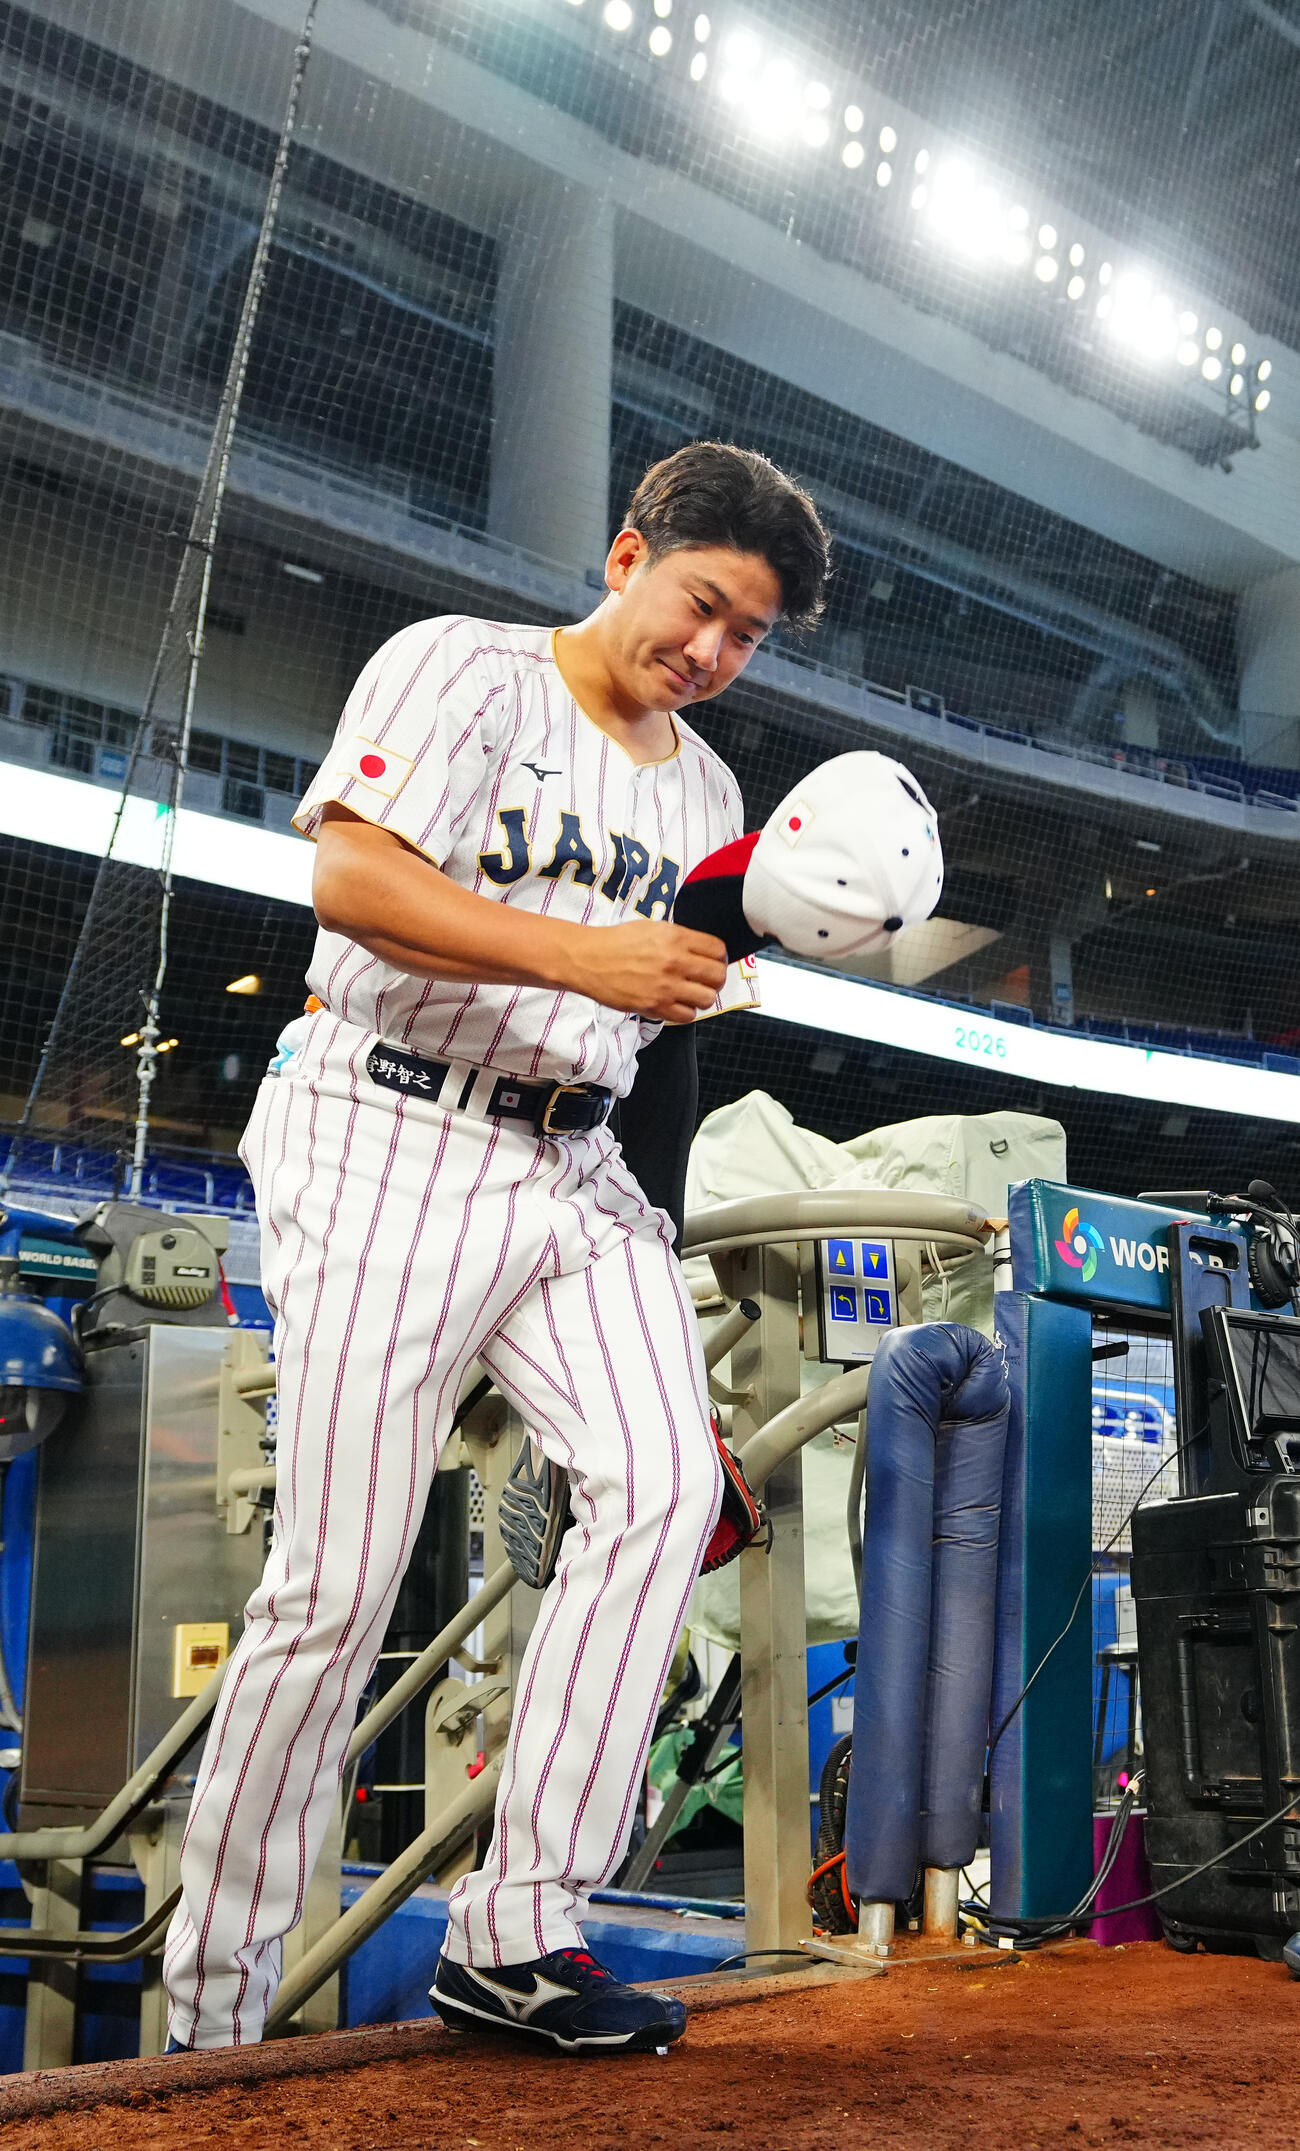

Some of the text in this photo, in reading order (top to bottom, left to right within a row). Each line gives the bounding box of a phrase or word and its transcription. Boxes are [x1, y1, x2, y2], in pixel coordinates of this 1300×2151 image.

[477, 806, 682, 922] JAPA
[954, 1027, 1007, 1058] 2026
[18, 1250, 62, 1266] WORLD
[1109, 1236, 1203, 1274] WOR
